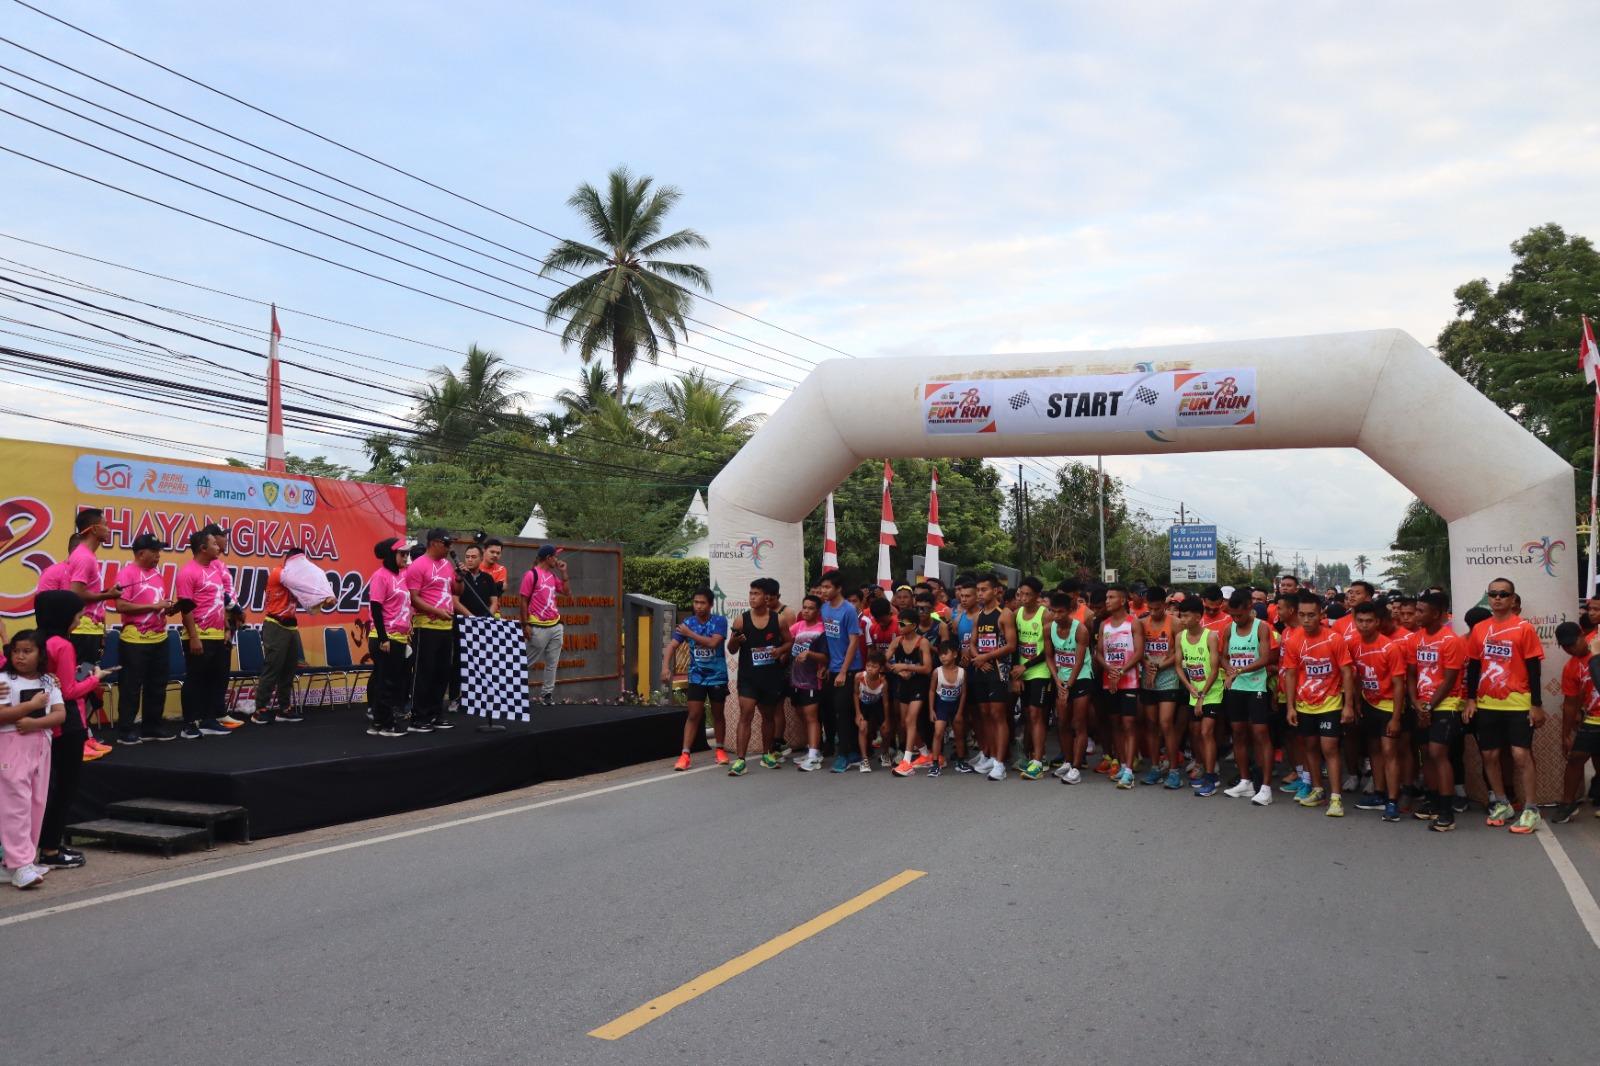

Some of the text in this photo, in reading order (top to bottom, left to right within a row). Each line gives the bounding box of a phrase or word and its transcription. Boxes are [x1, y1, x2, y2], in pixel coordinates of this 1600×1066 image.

[1047, 391, 1123, 419] START
[1178, 395, 1251, 411] FUN RUN
[927, 405, 991, 419] FUN RUN
[213, 489, 246, 501] antam
[76, 505, 339, 559] HAYANGKARA
[1466, 544, 1513, 552] wonderful
[1466, 553, 1534, 565] indonesia
[1307, 665, 1331, 673] 7077
